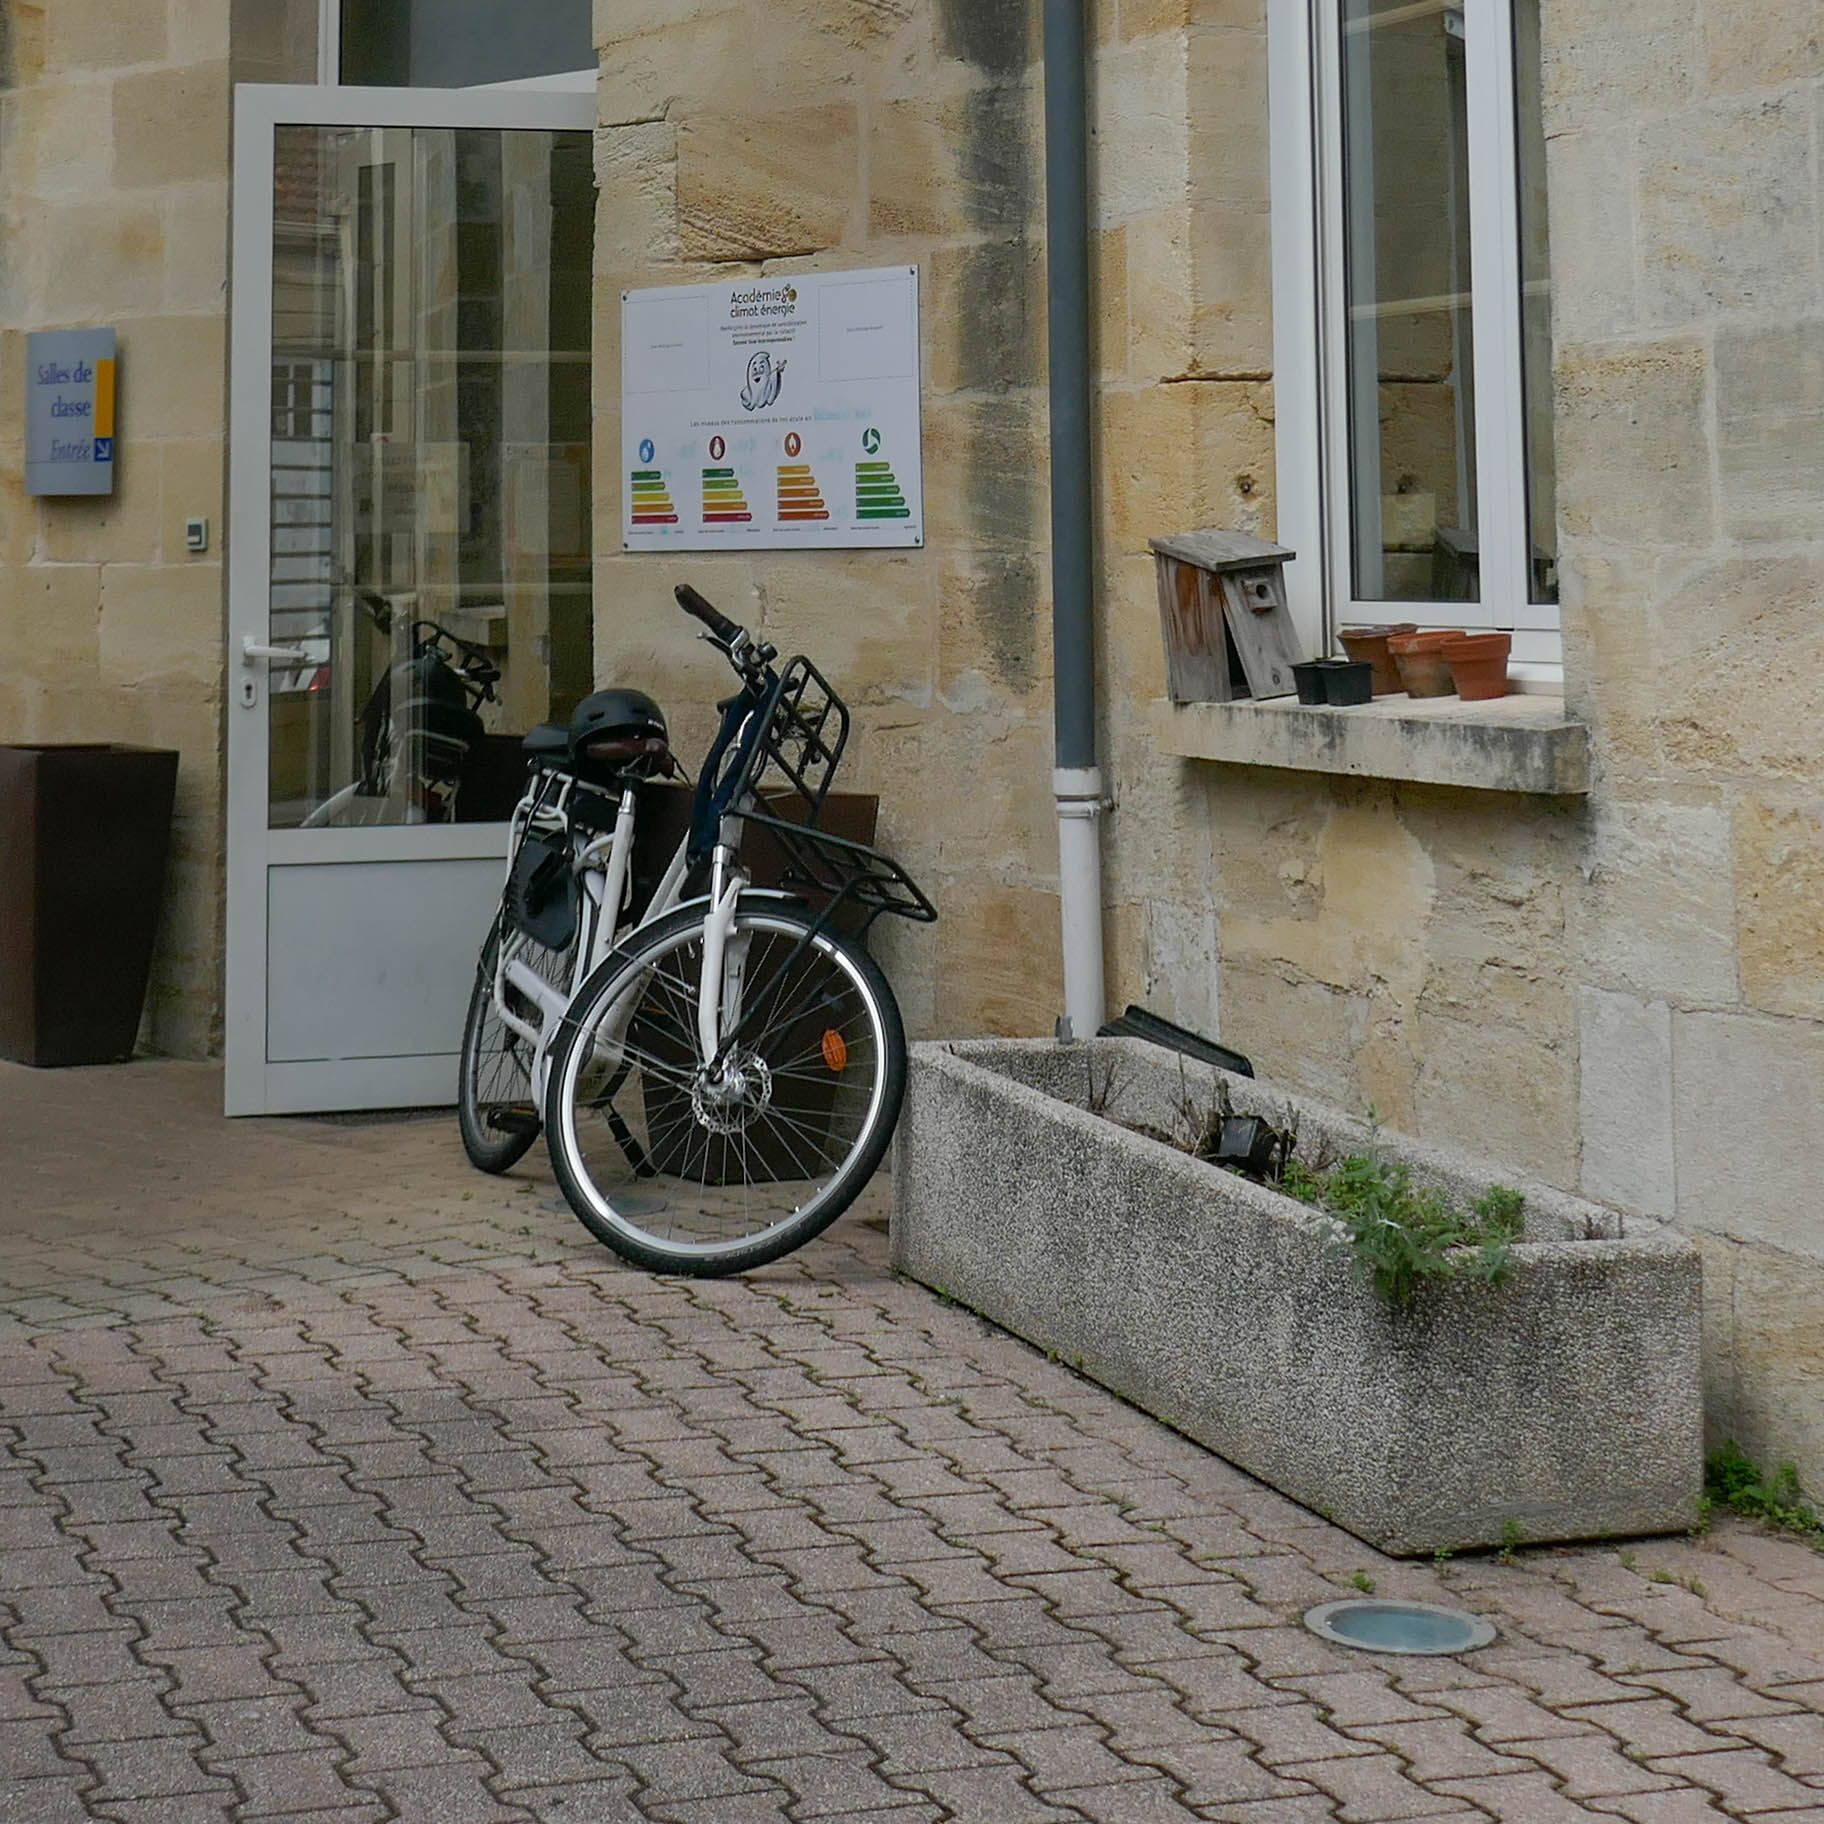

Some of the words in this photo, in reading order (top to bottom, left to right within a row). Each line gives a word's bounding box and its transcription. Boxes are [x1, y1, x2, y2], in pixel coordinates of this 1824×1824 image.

[730, 287, 781, 304] Académie
[760, 302, 795, 318] énergie
[37, 362, 70, 385] Salles
[74, 360, 92, 384] de
[51, 395, 91, 417] classe
[50, 438, 90, 461] Entrée
